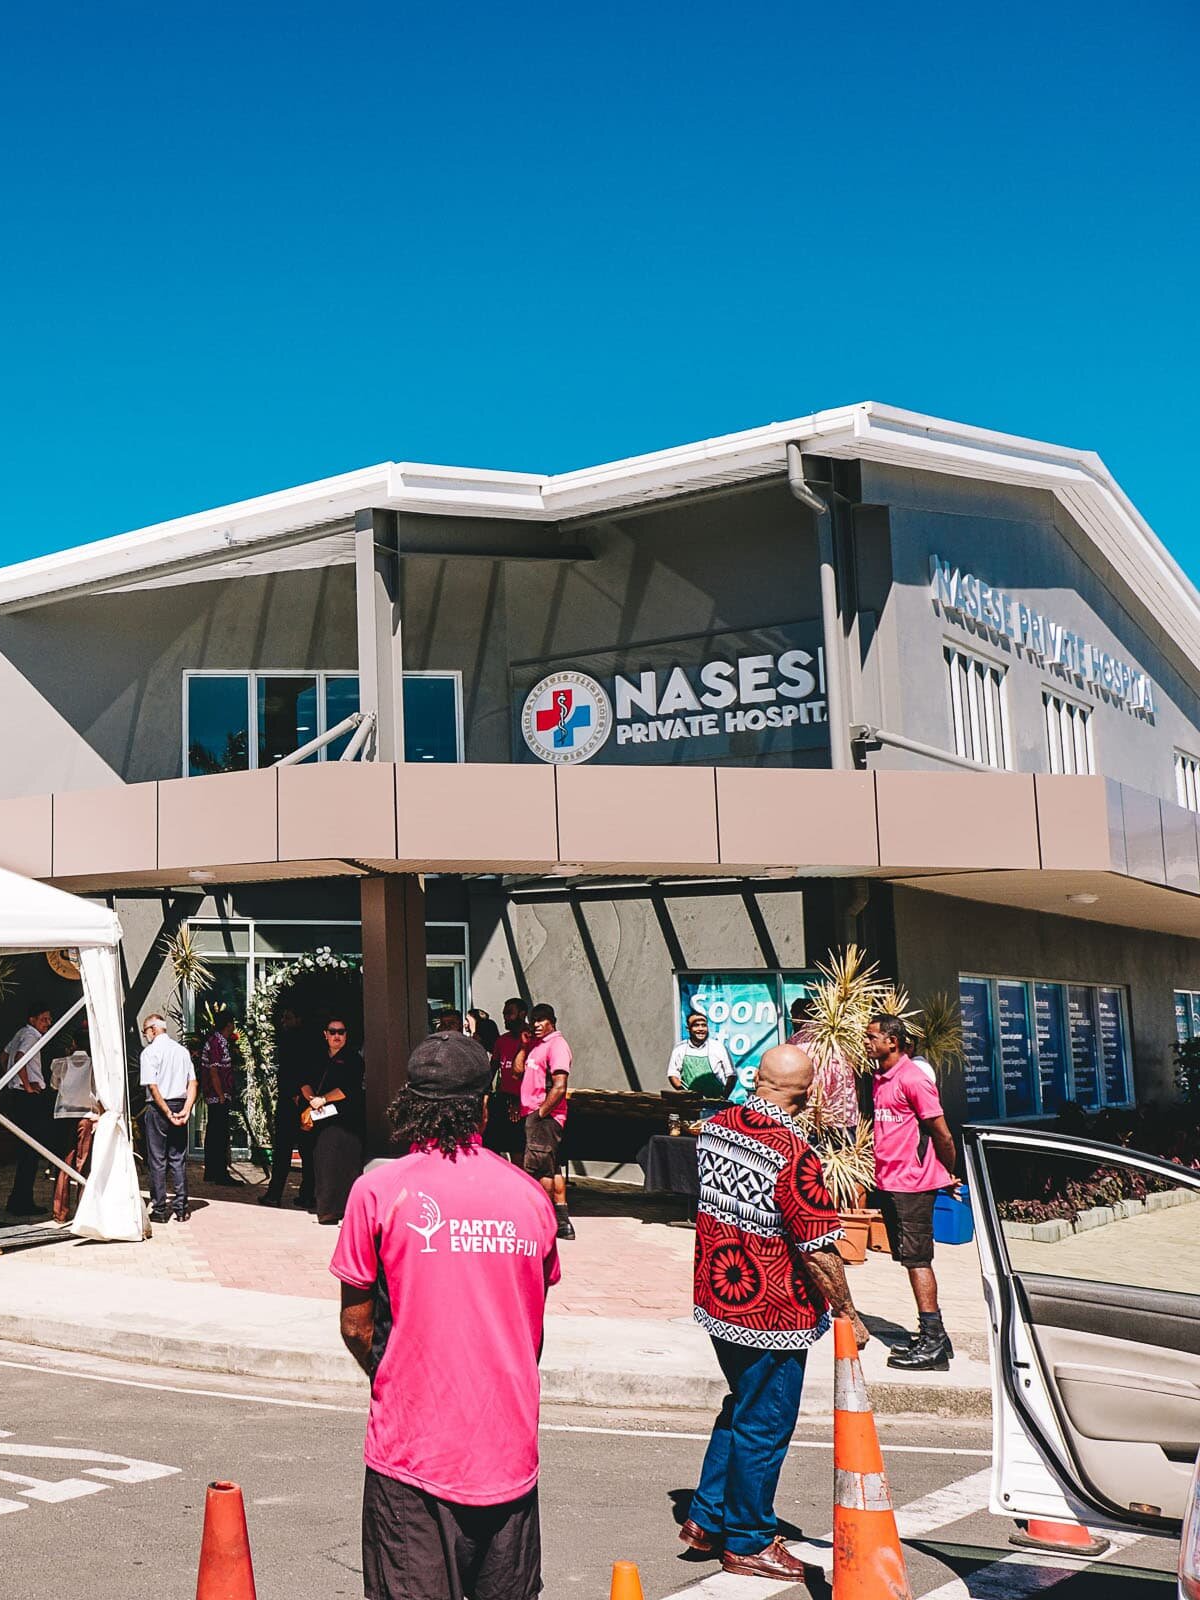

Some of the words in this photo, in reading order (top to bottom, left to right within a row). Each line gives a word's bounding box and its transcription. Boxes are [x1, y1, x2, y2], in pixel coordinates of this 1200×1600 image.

[930, 553, 1015, 638] NASESE
[1011, 602, 1087, 678] PRIVATE
[1084, 644, 1158, 713] HOSPITA
[615, 646, 826, 719] NASES
[616, 713, 720, 745] PRIVATE
[724, 700, 828, 733] HOSPIT
[691, 993, 776, 1023] Soon
[450, 1235, 515, 1254] EVENTS
[515, 1238, 538, 1257] FIJI
